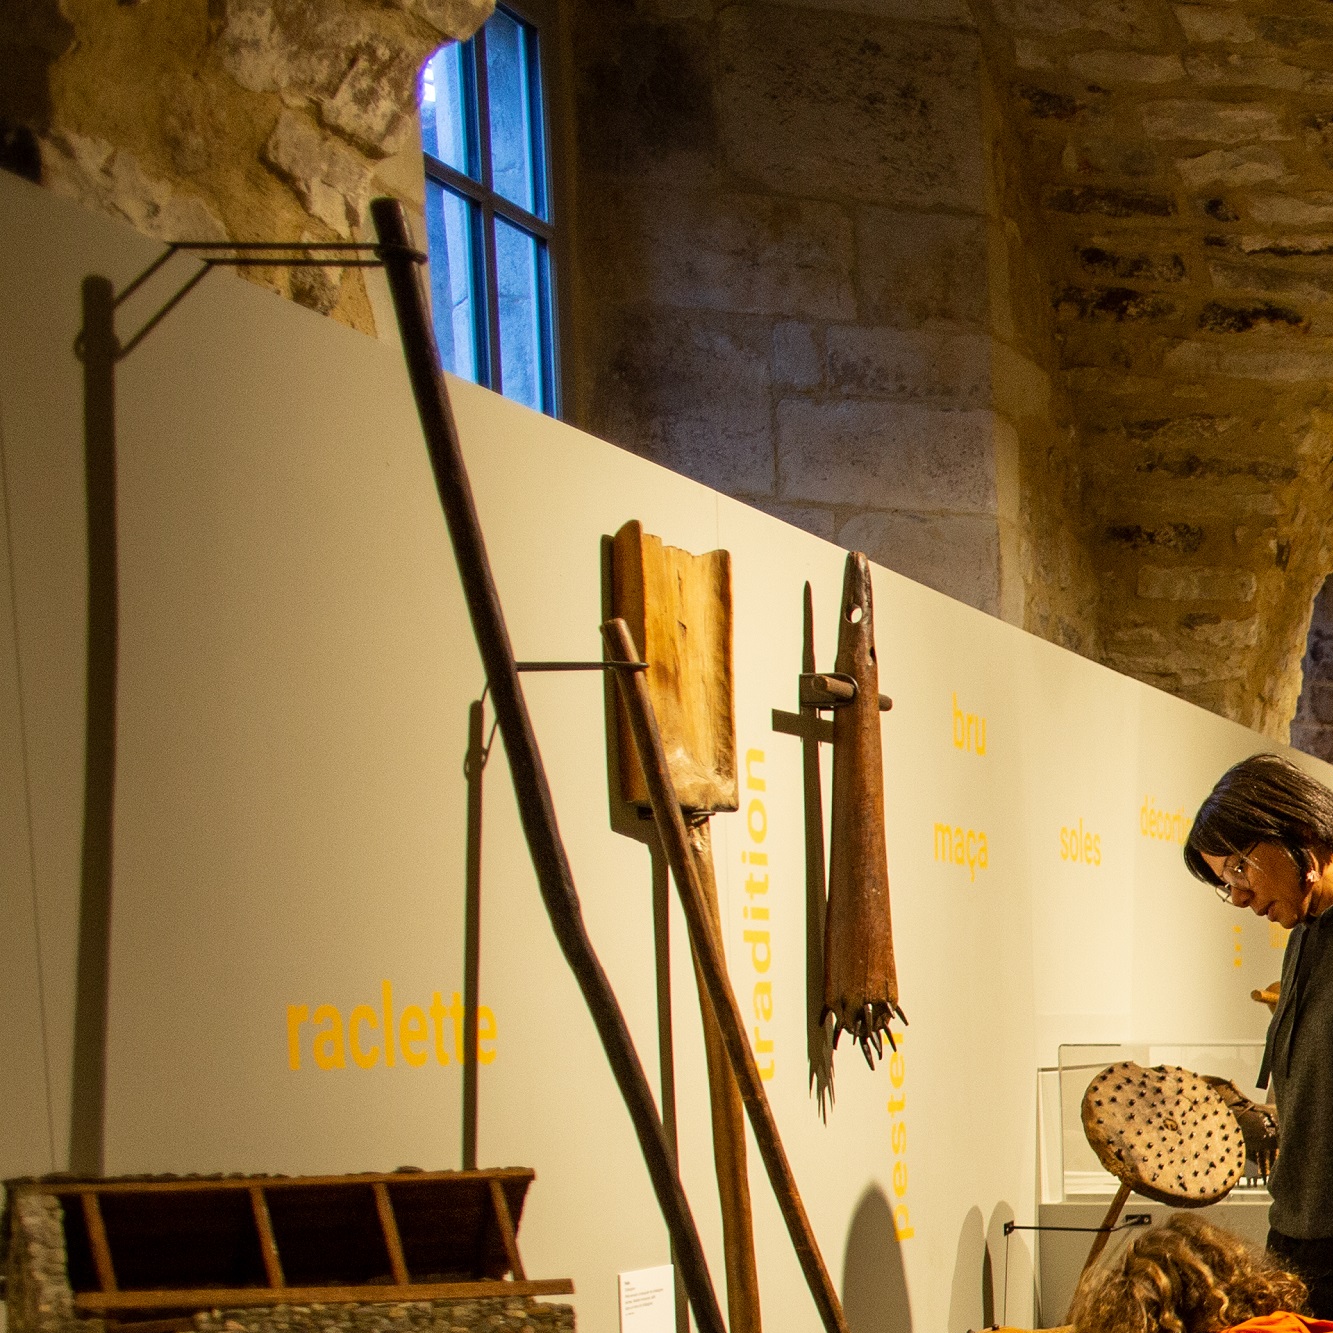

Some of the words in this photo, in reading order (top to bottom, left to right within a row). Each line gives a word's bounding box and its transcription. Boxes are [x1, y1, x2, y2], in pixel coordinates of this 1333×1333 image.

[952, 691, 987, 756] bru
[934, 822, 989, 883] maça
[1060, 817, 1101, 866] soles
[742, 748, 775, 1082] tradition
[287, 979, 498, 1071] raclette
